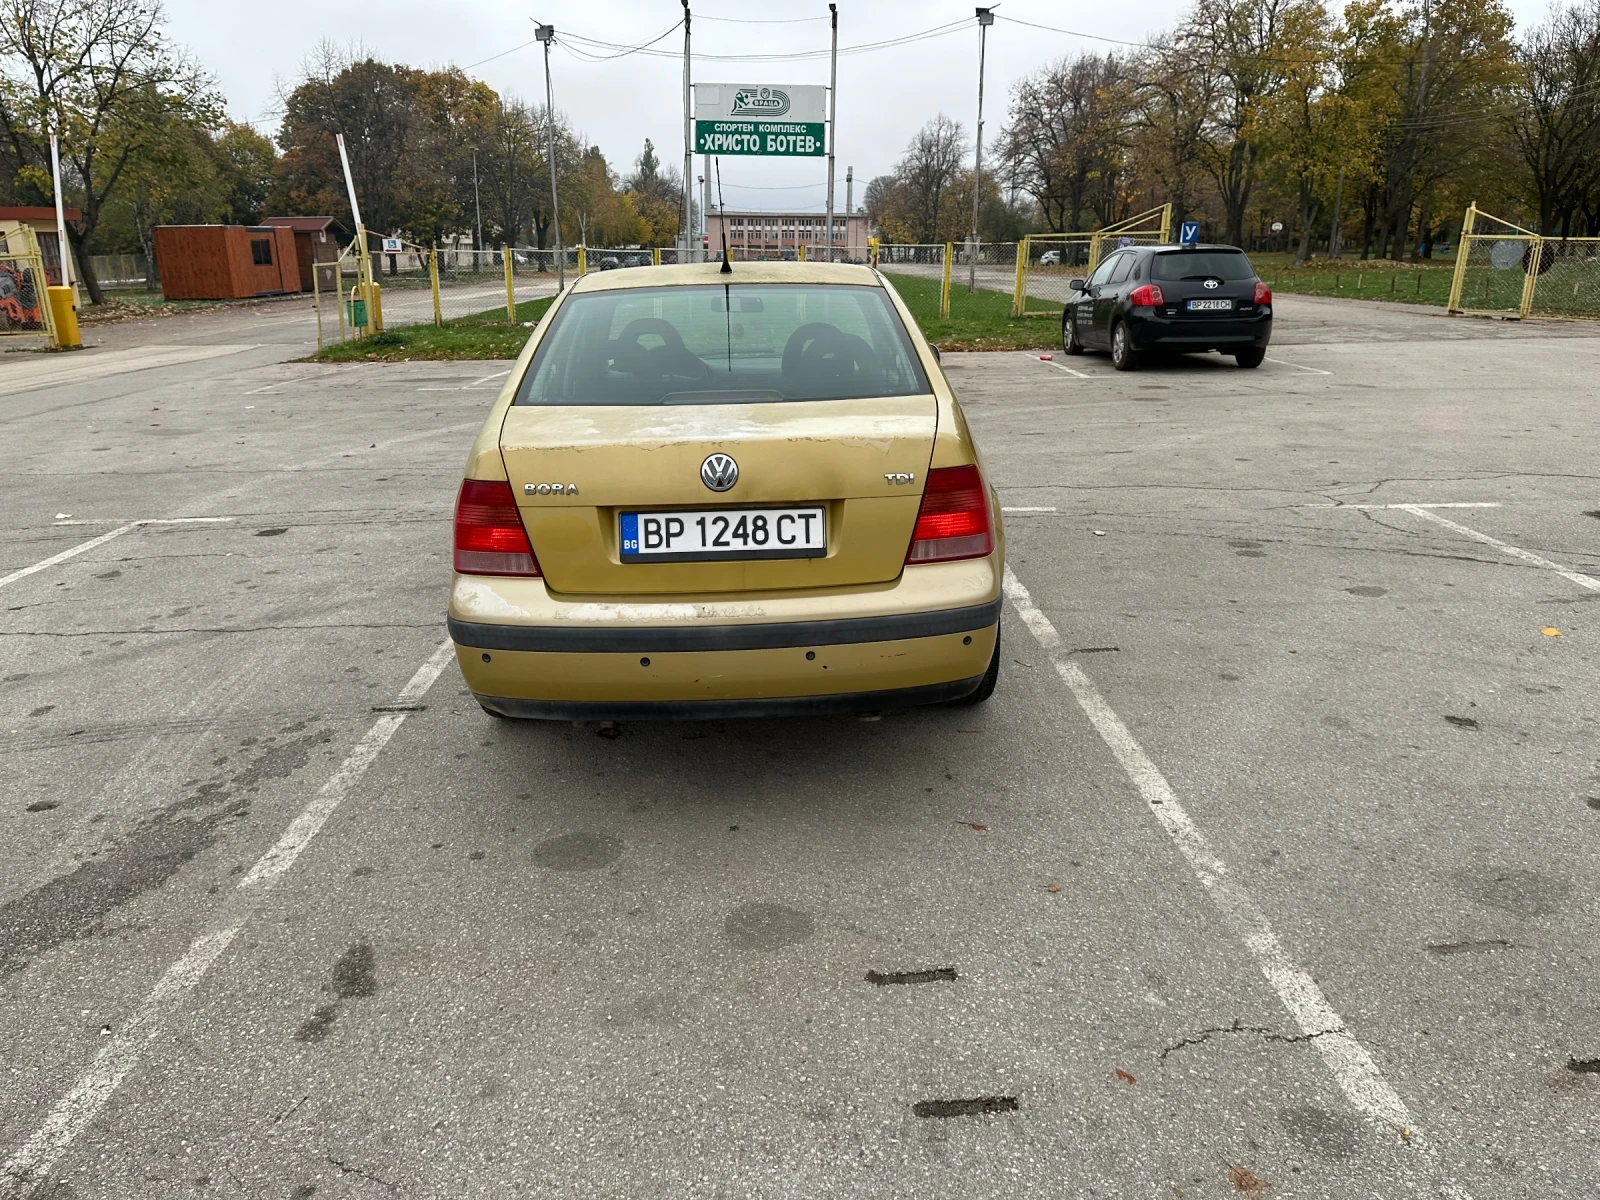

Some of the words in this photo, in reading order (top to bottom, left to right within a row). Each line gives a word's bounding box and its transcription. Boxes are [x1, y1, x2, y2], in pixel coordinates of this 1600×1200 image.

[714, 123, 754, 132] СПОРТЕН
[758, 124, 807, 133] КОМПЛЕКС
[704, 133, 760, 151] ХРИСТО
[766, 135, 815, 153] БОТЕВ
[1192, 301, 1202, 309] BP
[1220, 300, 1231, 308] CH
[884, 472, 914, 485] TDI
[524, 483, 579, 496] BORA
[643, 517, 685, 549] BP
[696, 514, 770, 547] 1248
[776, 513, 817, 545] CT
[623, 539, 638, 550] BG
